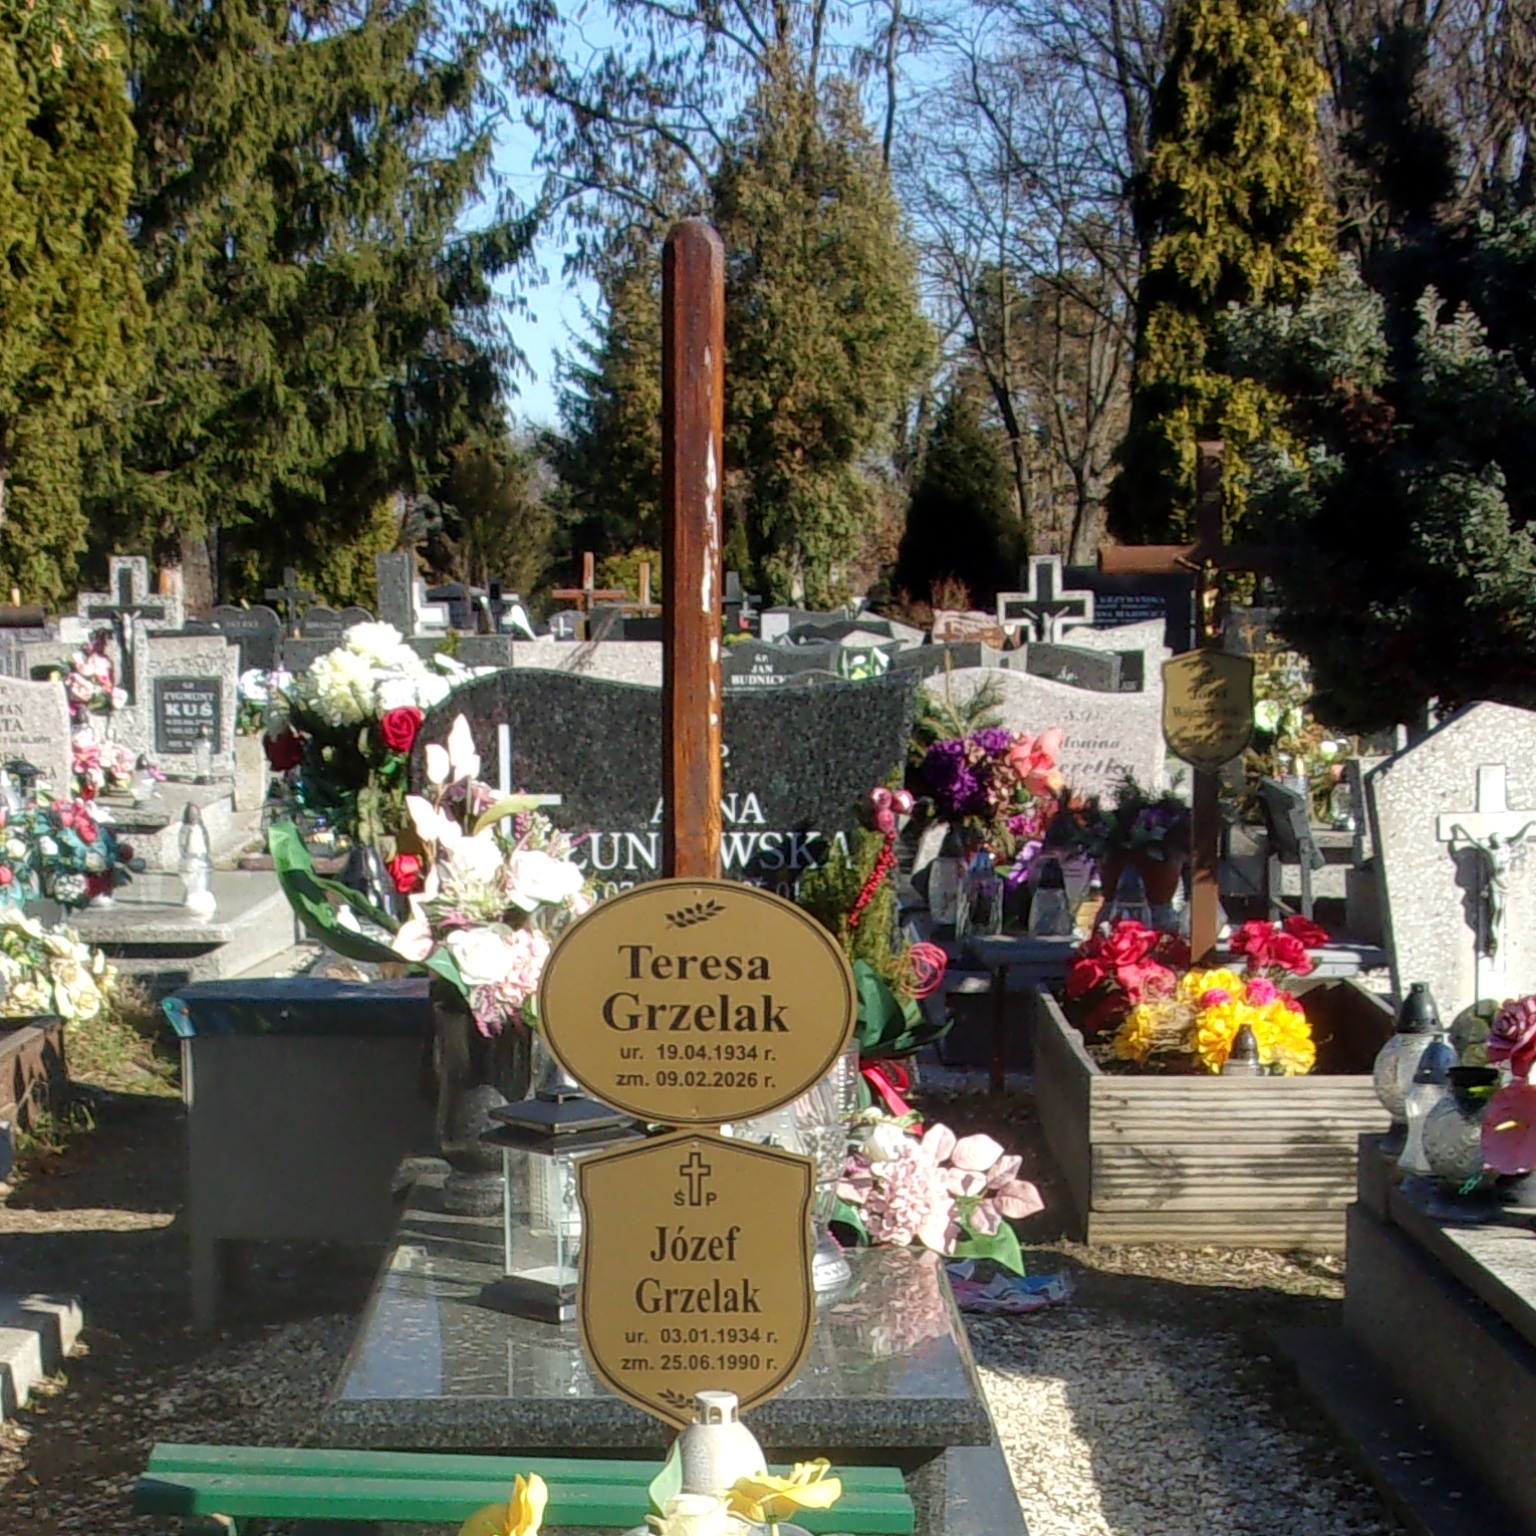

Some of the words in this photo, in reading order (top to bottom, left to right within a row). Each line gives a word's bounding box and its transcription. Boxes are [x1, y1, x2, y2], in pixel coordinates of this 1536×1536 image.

[165, 700, 214, 717] KUŚ
[650, 791, 767, 825] ANA
[617, 944, 771, 981] Teresa
[602, 991, 790, 1033] Grzelak
[620, 1047, 644, 1060] ur.
[656, 1043, 758, 1062] 19.04.1934
[764, 1047, 776, 1062] r.
[616, 1074, 650, 1087] zm.
[656, 1071, 758, 1088] 09.02.2026
[764, 1074, 776, 1088] r.
[650, 1225, 741, 1263] Józef
[635, 1277, 762, 1314] Grzelak
[625, 1331, 648, 1344] ur.
[660, 1327, 761, 1344] 03.01.1934
[766, 1330, 778, 1344] r.
[621, 1357, 655, 1371] zm.
[660, 1354, 761, 1371] 25.06.1990
[766, 1357, 778, 1371] r.
